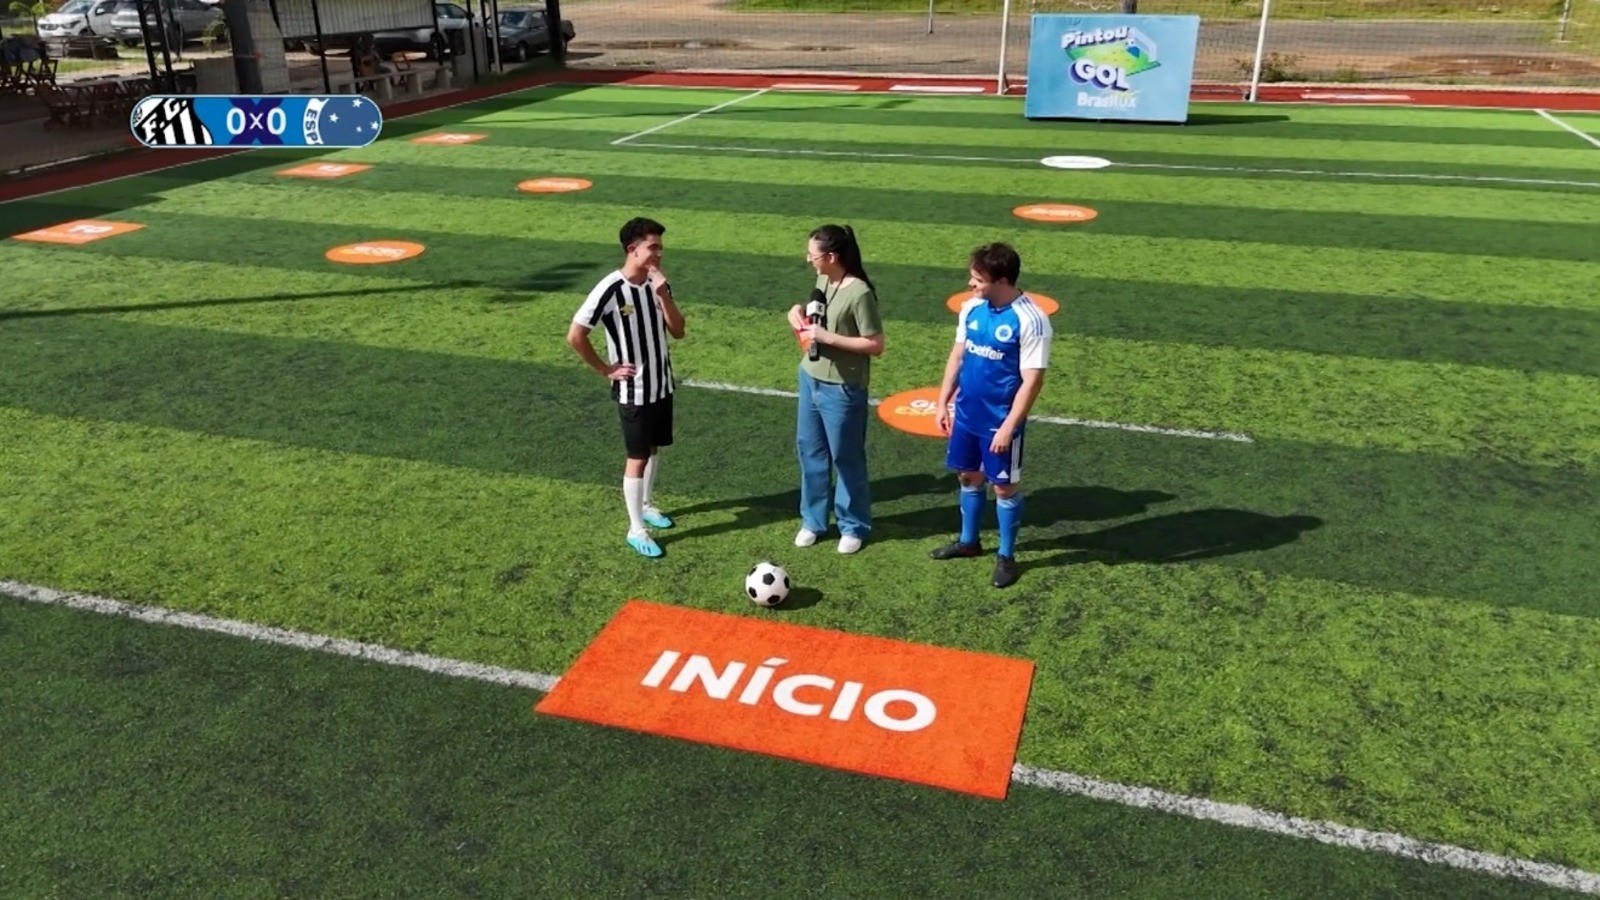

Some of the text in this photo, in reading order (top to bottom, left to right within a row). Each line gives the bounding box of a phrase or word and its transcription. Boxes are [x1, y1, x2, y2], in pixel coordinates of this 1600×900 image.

[1061, 26, 1129, 49] Pintou
[1071, 58, 1130, 90] GOL
[1077, 92, 1137, 107] Brasilux
[968, 342, 1006, 360] betfair
[640, 650, 937, 732] INÍCIO
